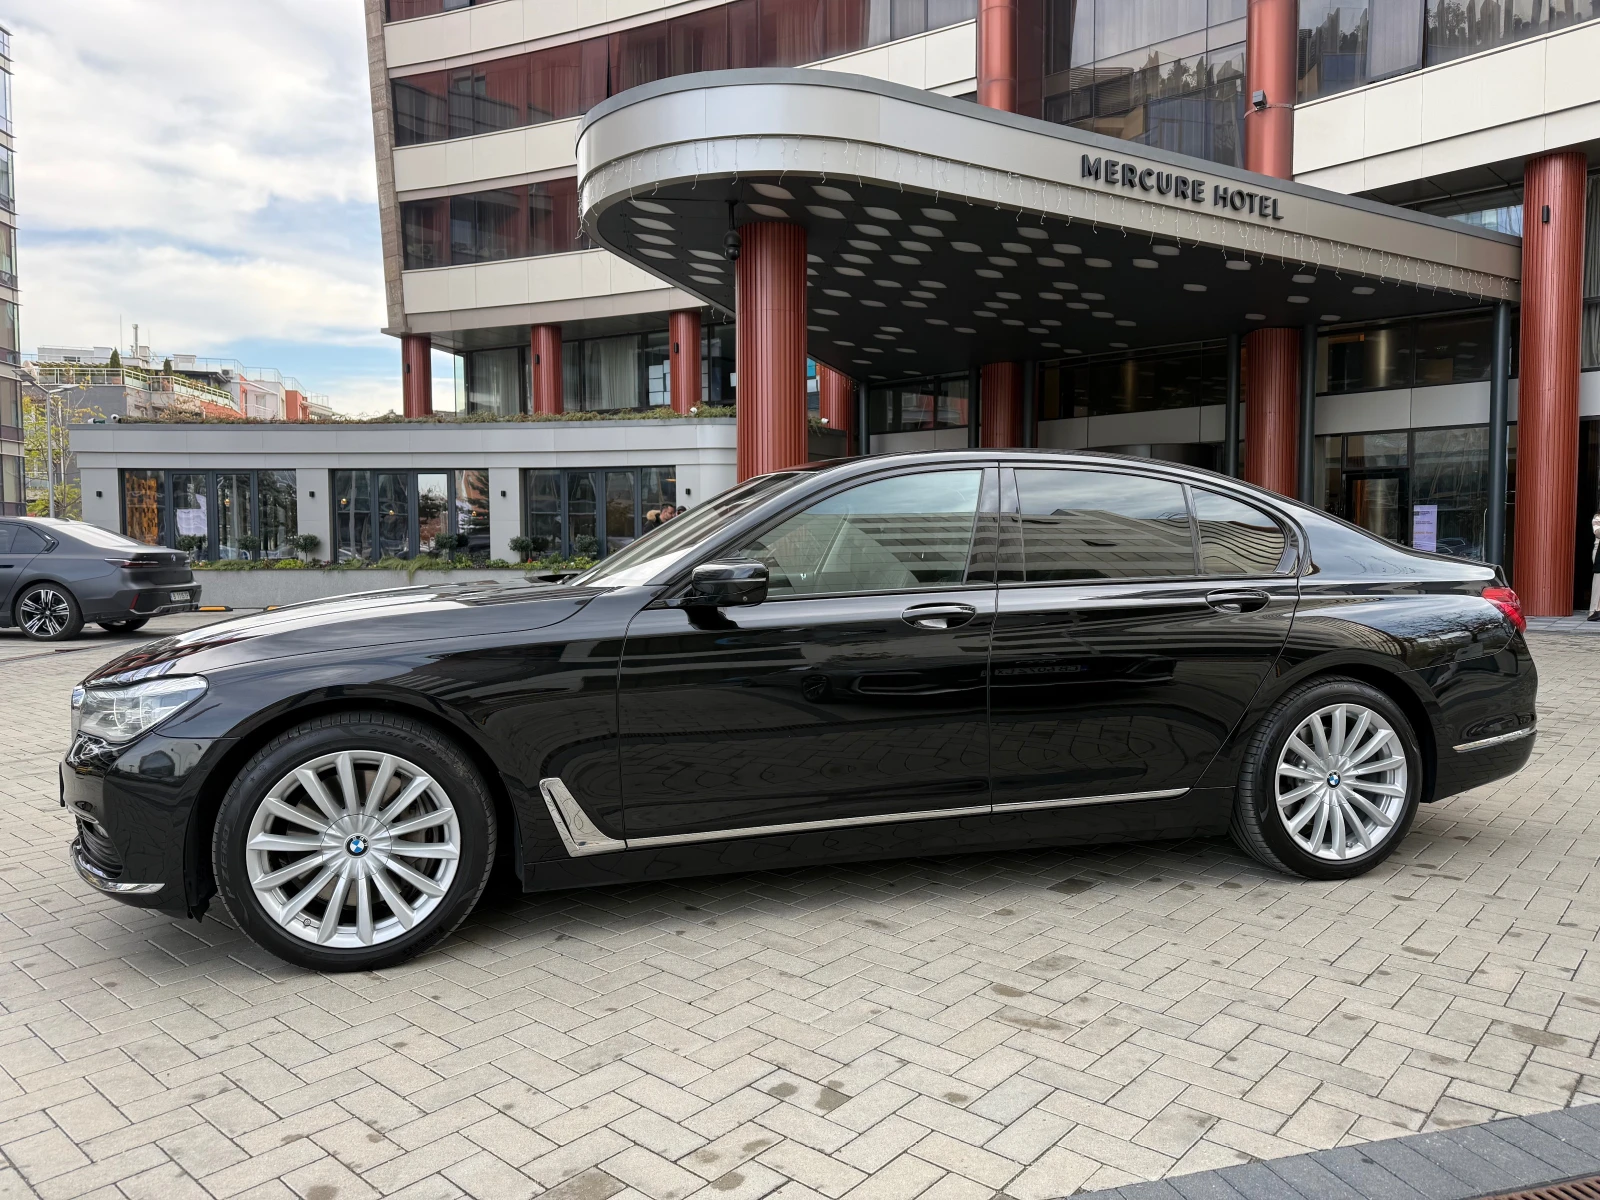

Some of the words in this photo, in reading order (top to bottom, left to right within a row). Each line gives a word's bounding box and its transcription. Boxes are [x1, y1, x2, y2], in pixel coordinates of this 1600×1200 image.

[1081, 153, 1205, 202] MERCURE
[1213, 184, 1284, 220] HOTEL
[369, 728, 416, 743] 245/45
[417, 742, 437, 755] R19
[220, 823, 230, 882] ZERO
[225, 886, 236, 899] P
